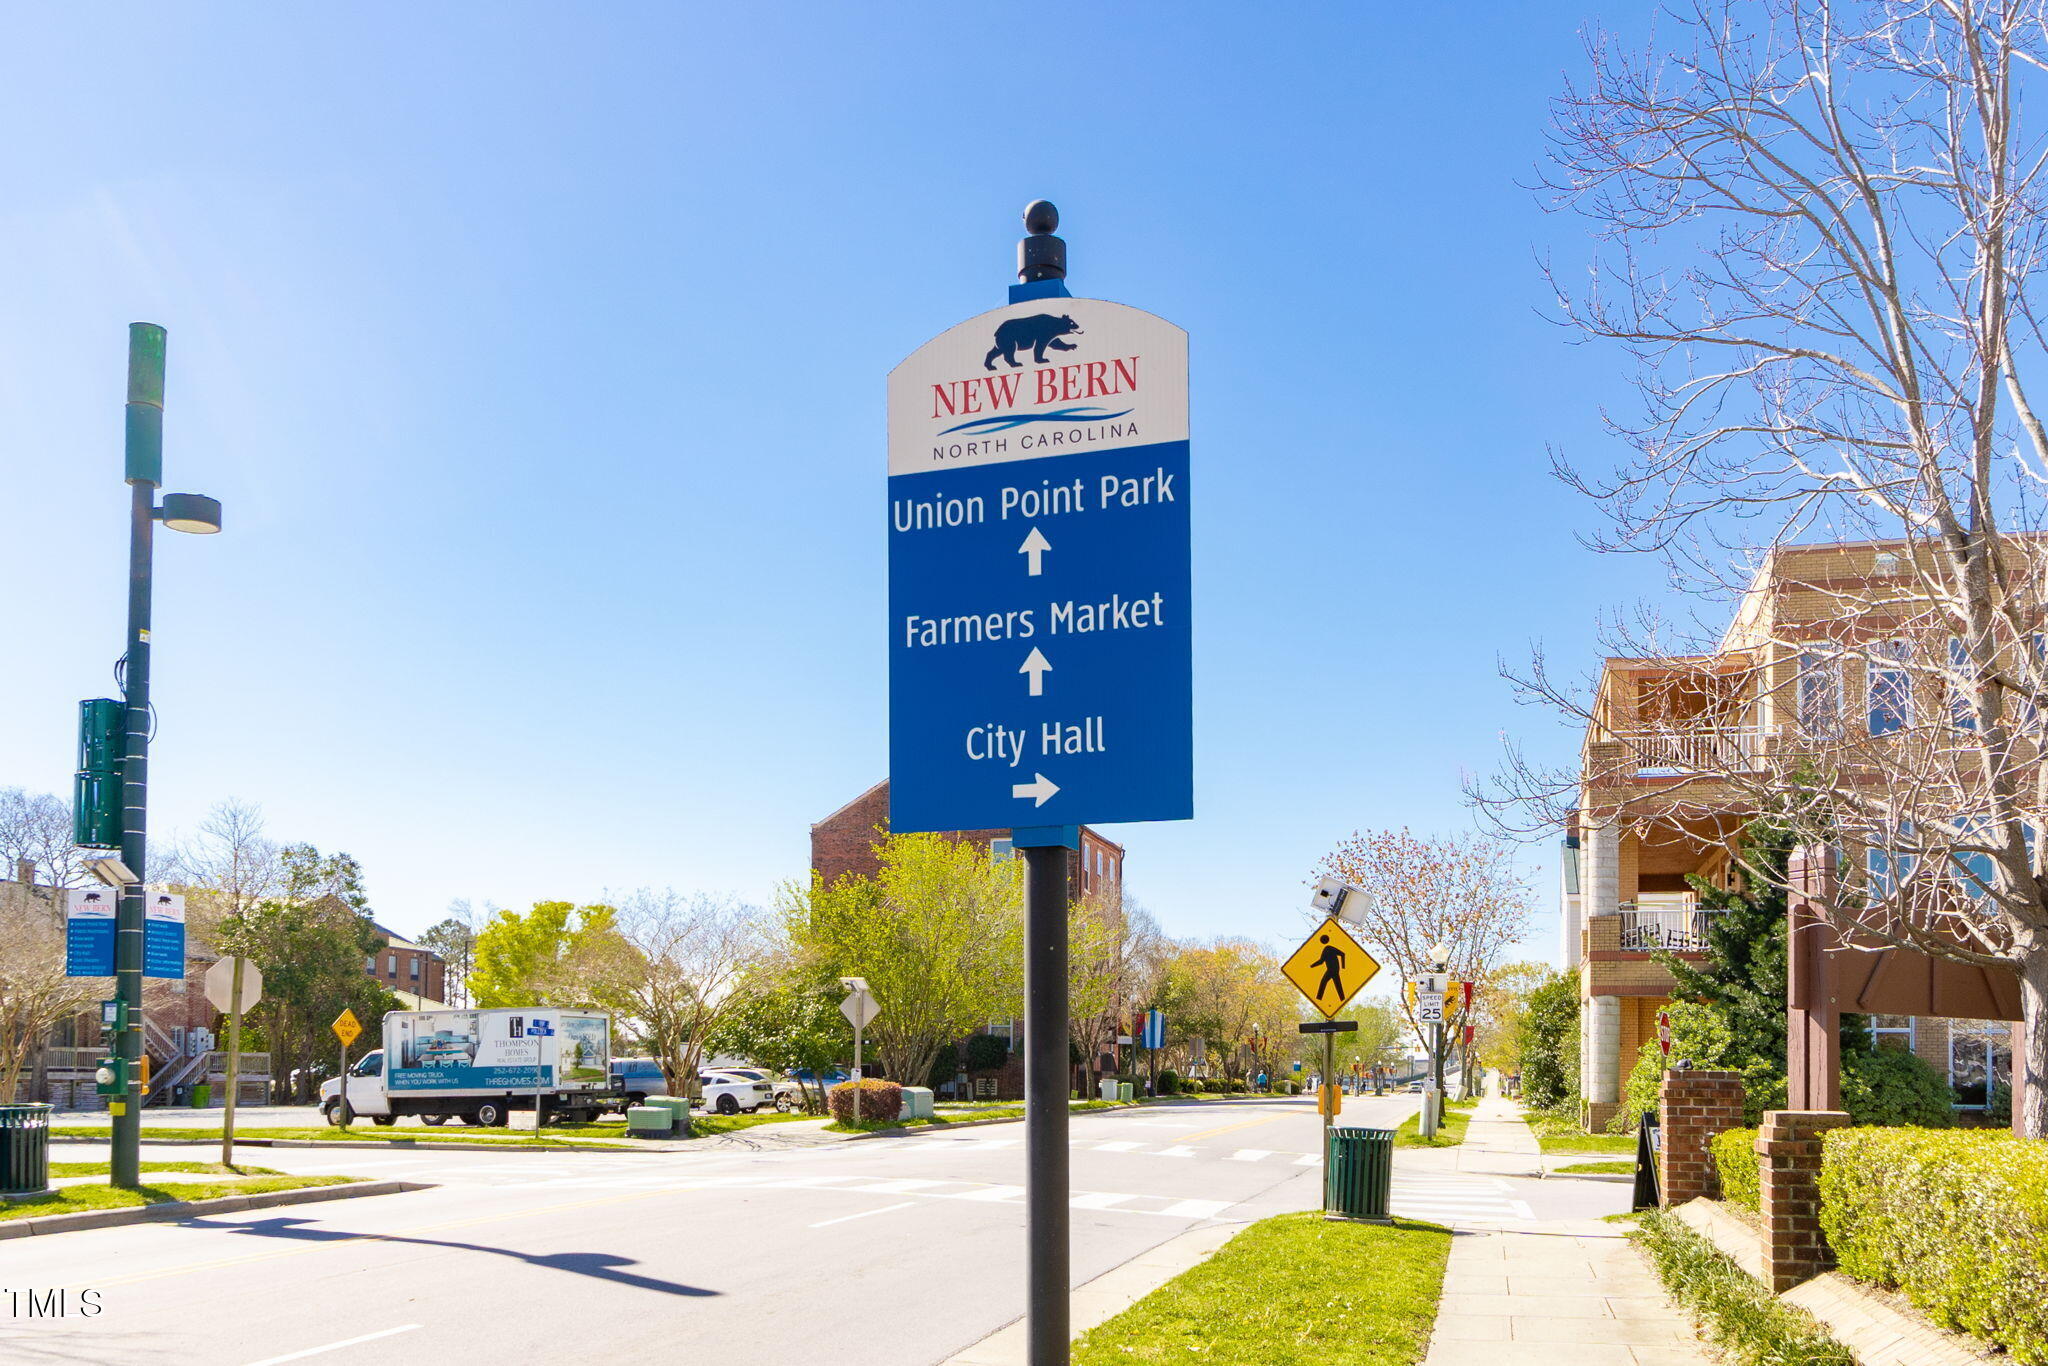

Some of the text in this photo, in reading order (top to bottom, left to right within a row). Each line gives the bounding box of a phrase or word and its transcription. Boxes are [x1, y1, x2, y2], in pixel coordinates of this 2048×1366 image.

[931, 355, 1141, 419] NEW BERN
[933, 421, 1139, 461] NORTH CAROLINA
[894, 467, 1176, 532] Union Point Park
[905, 592, 1164, 648] Farmers Market
[966, 715, 1106, 768] City Hall
[339, 1020, 357, 1028] DEAD
[1422, 1008, 1441, 1019] 25
[495, 1039, 540, 1048] THOMPSON
